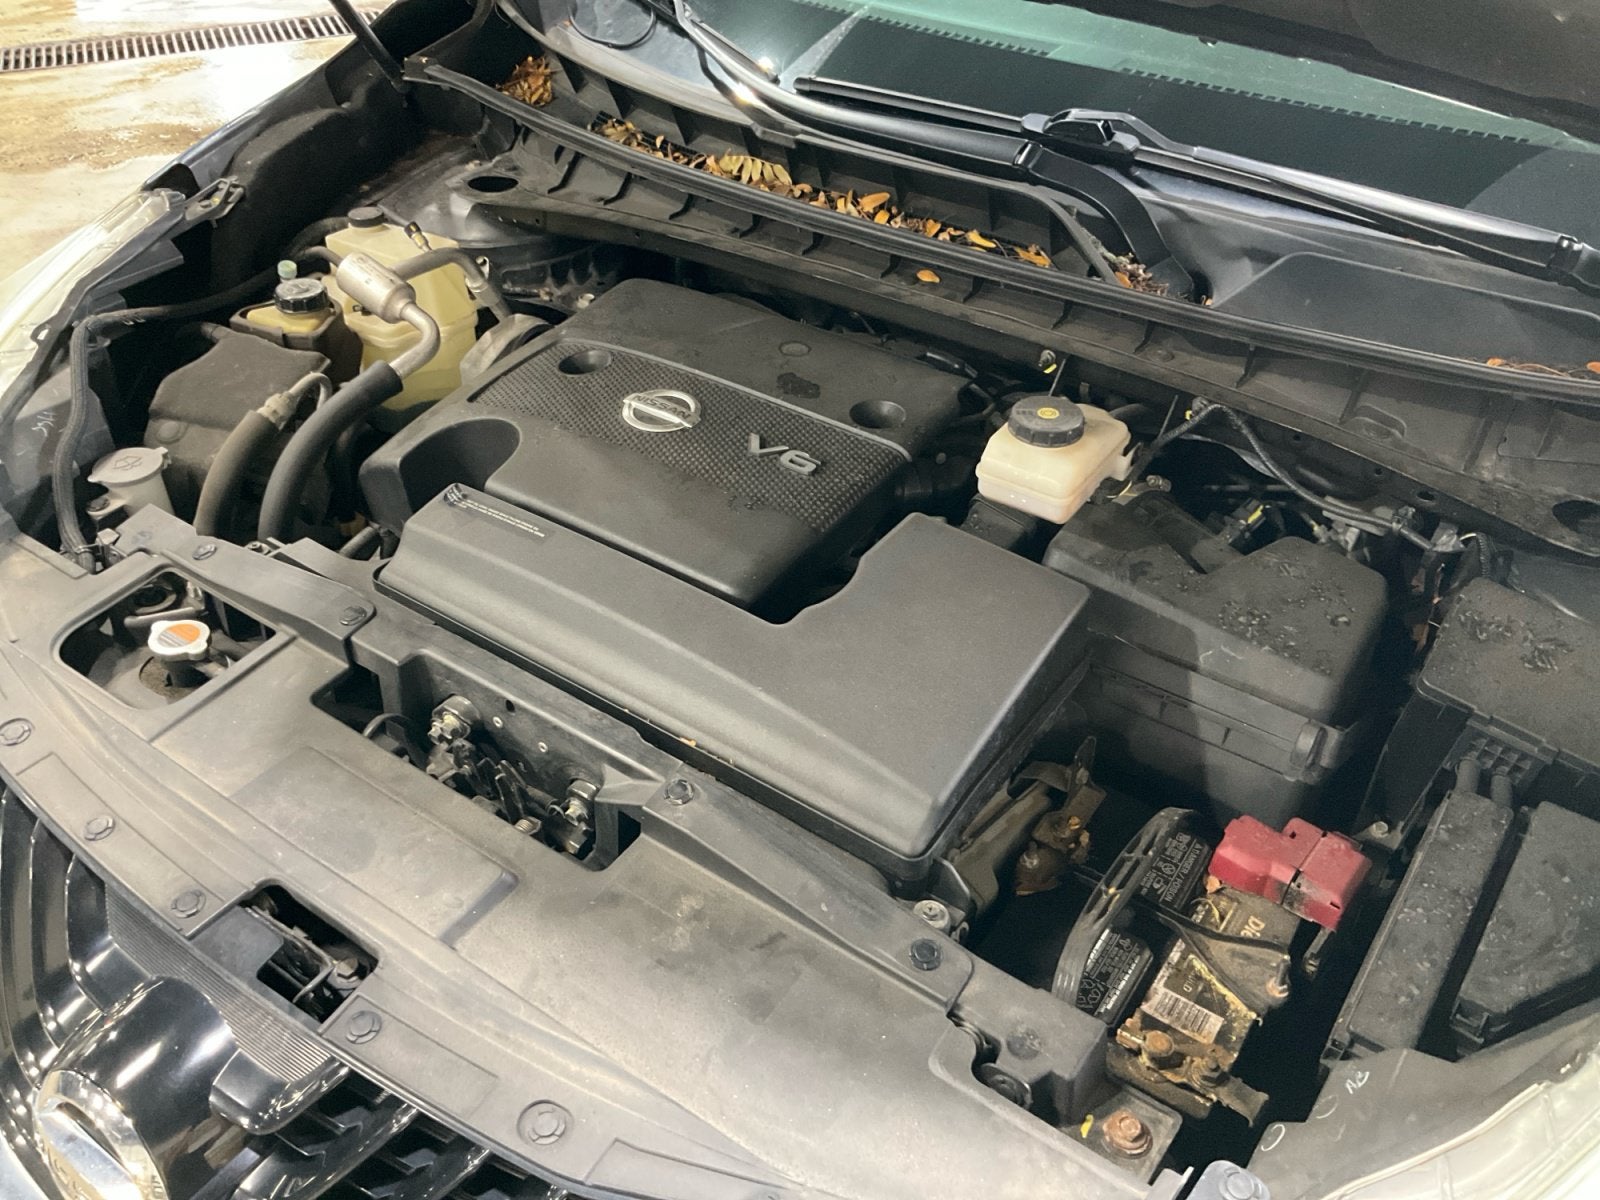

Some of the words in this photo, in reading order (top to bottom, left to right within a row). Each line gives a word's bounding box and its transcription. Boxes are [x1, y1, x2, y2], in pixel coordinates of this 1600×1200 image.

[634, 394, 692, 420] NISSAN
[749, 432, 821, 477] V6
[1181, 849, 1202, 874] DANGER
[1164, 878, 1184, 902] POISON
